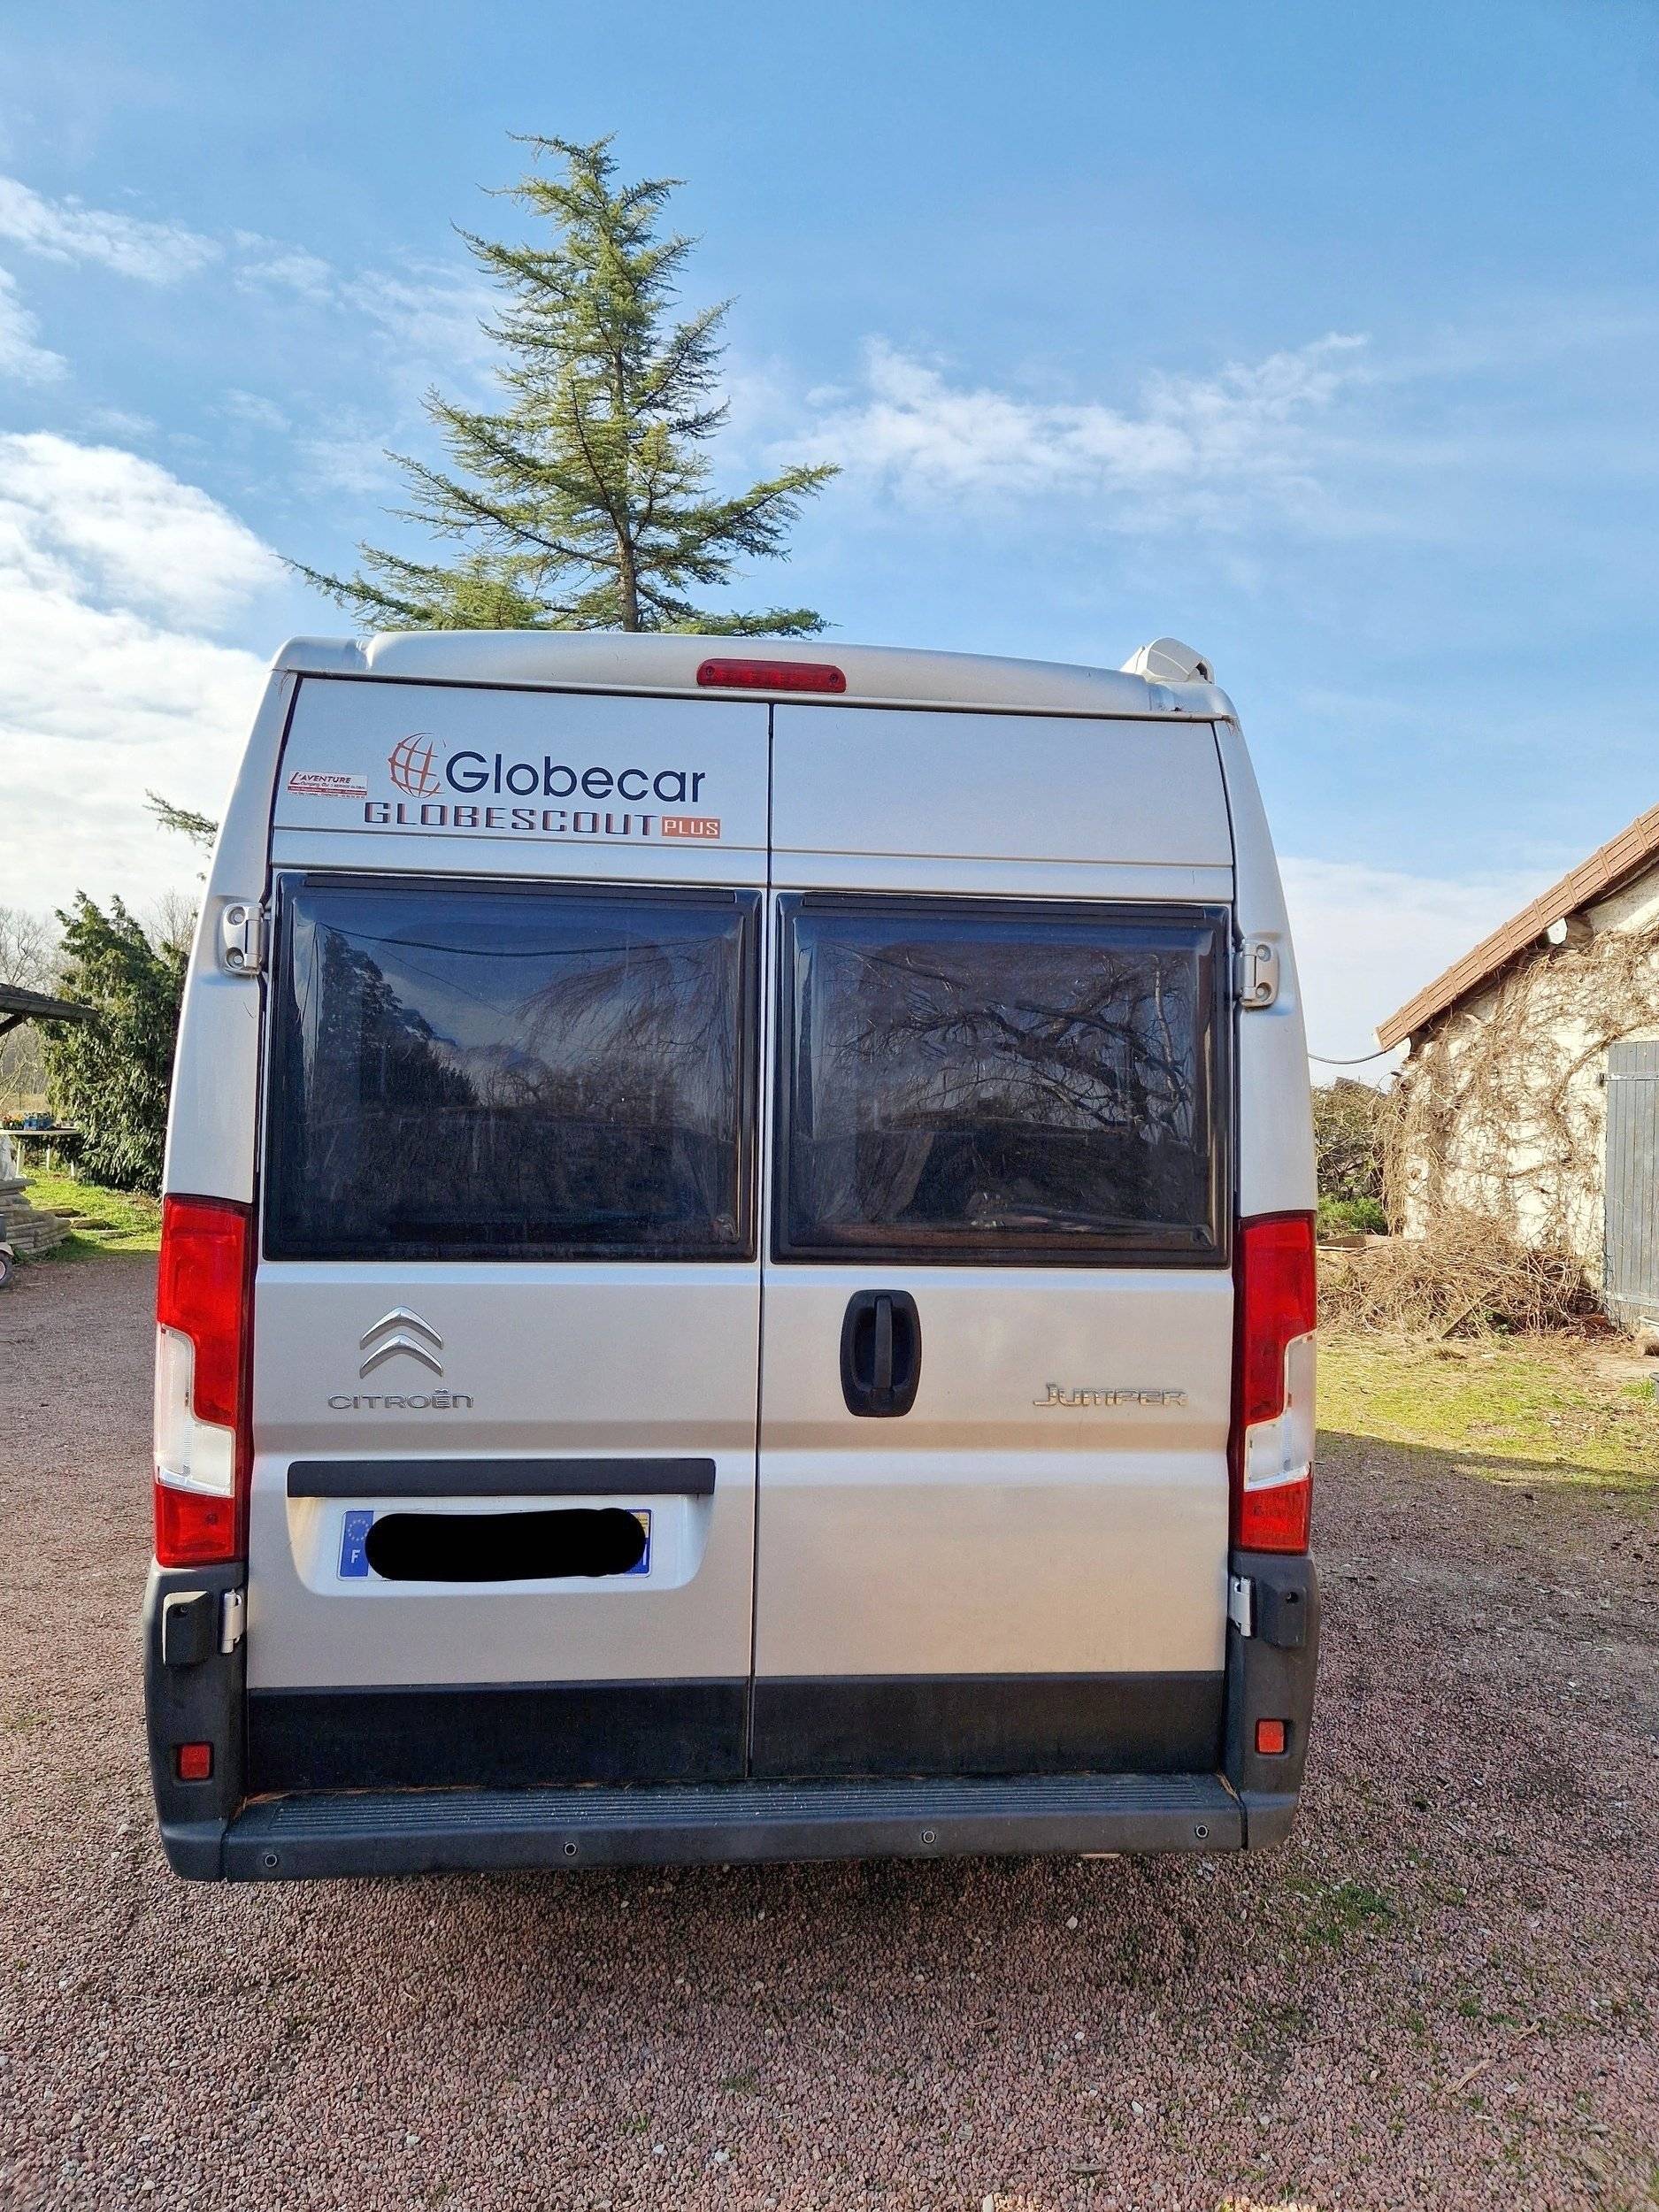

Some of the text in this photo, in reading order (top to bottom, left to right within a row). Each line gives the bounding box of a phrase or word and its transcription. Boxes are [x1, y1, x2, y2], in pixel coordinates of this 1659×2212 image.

[446, 750, 706, 802] Globecar
[364, 802, 719, 837] GLOBESCOUT PLUS
[1033, 1383, 1189, 1407] JUMPER
[350, 1549, 361, 1563] F
